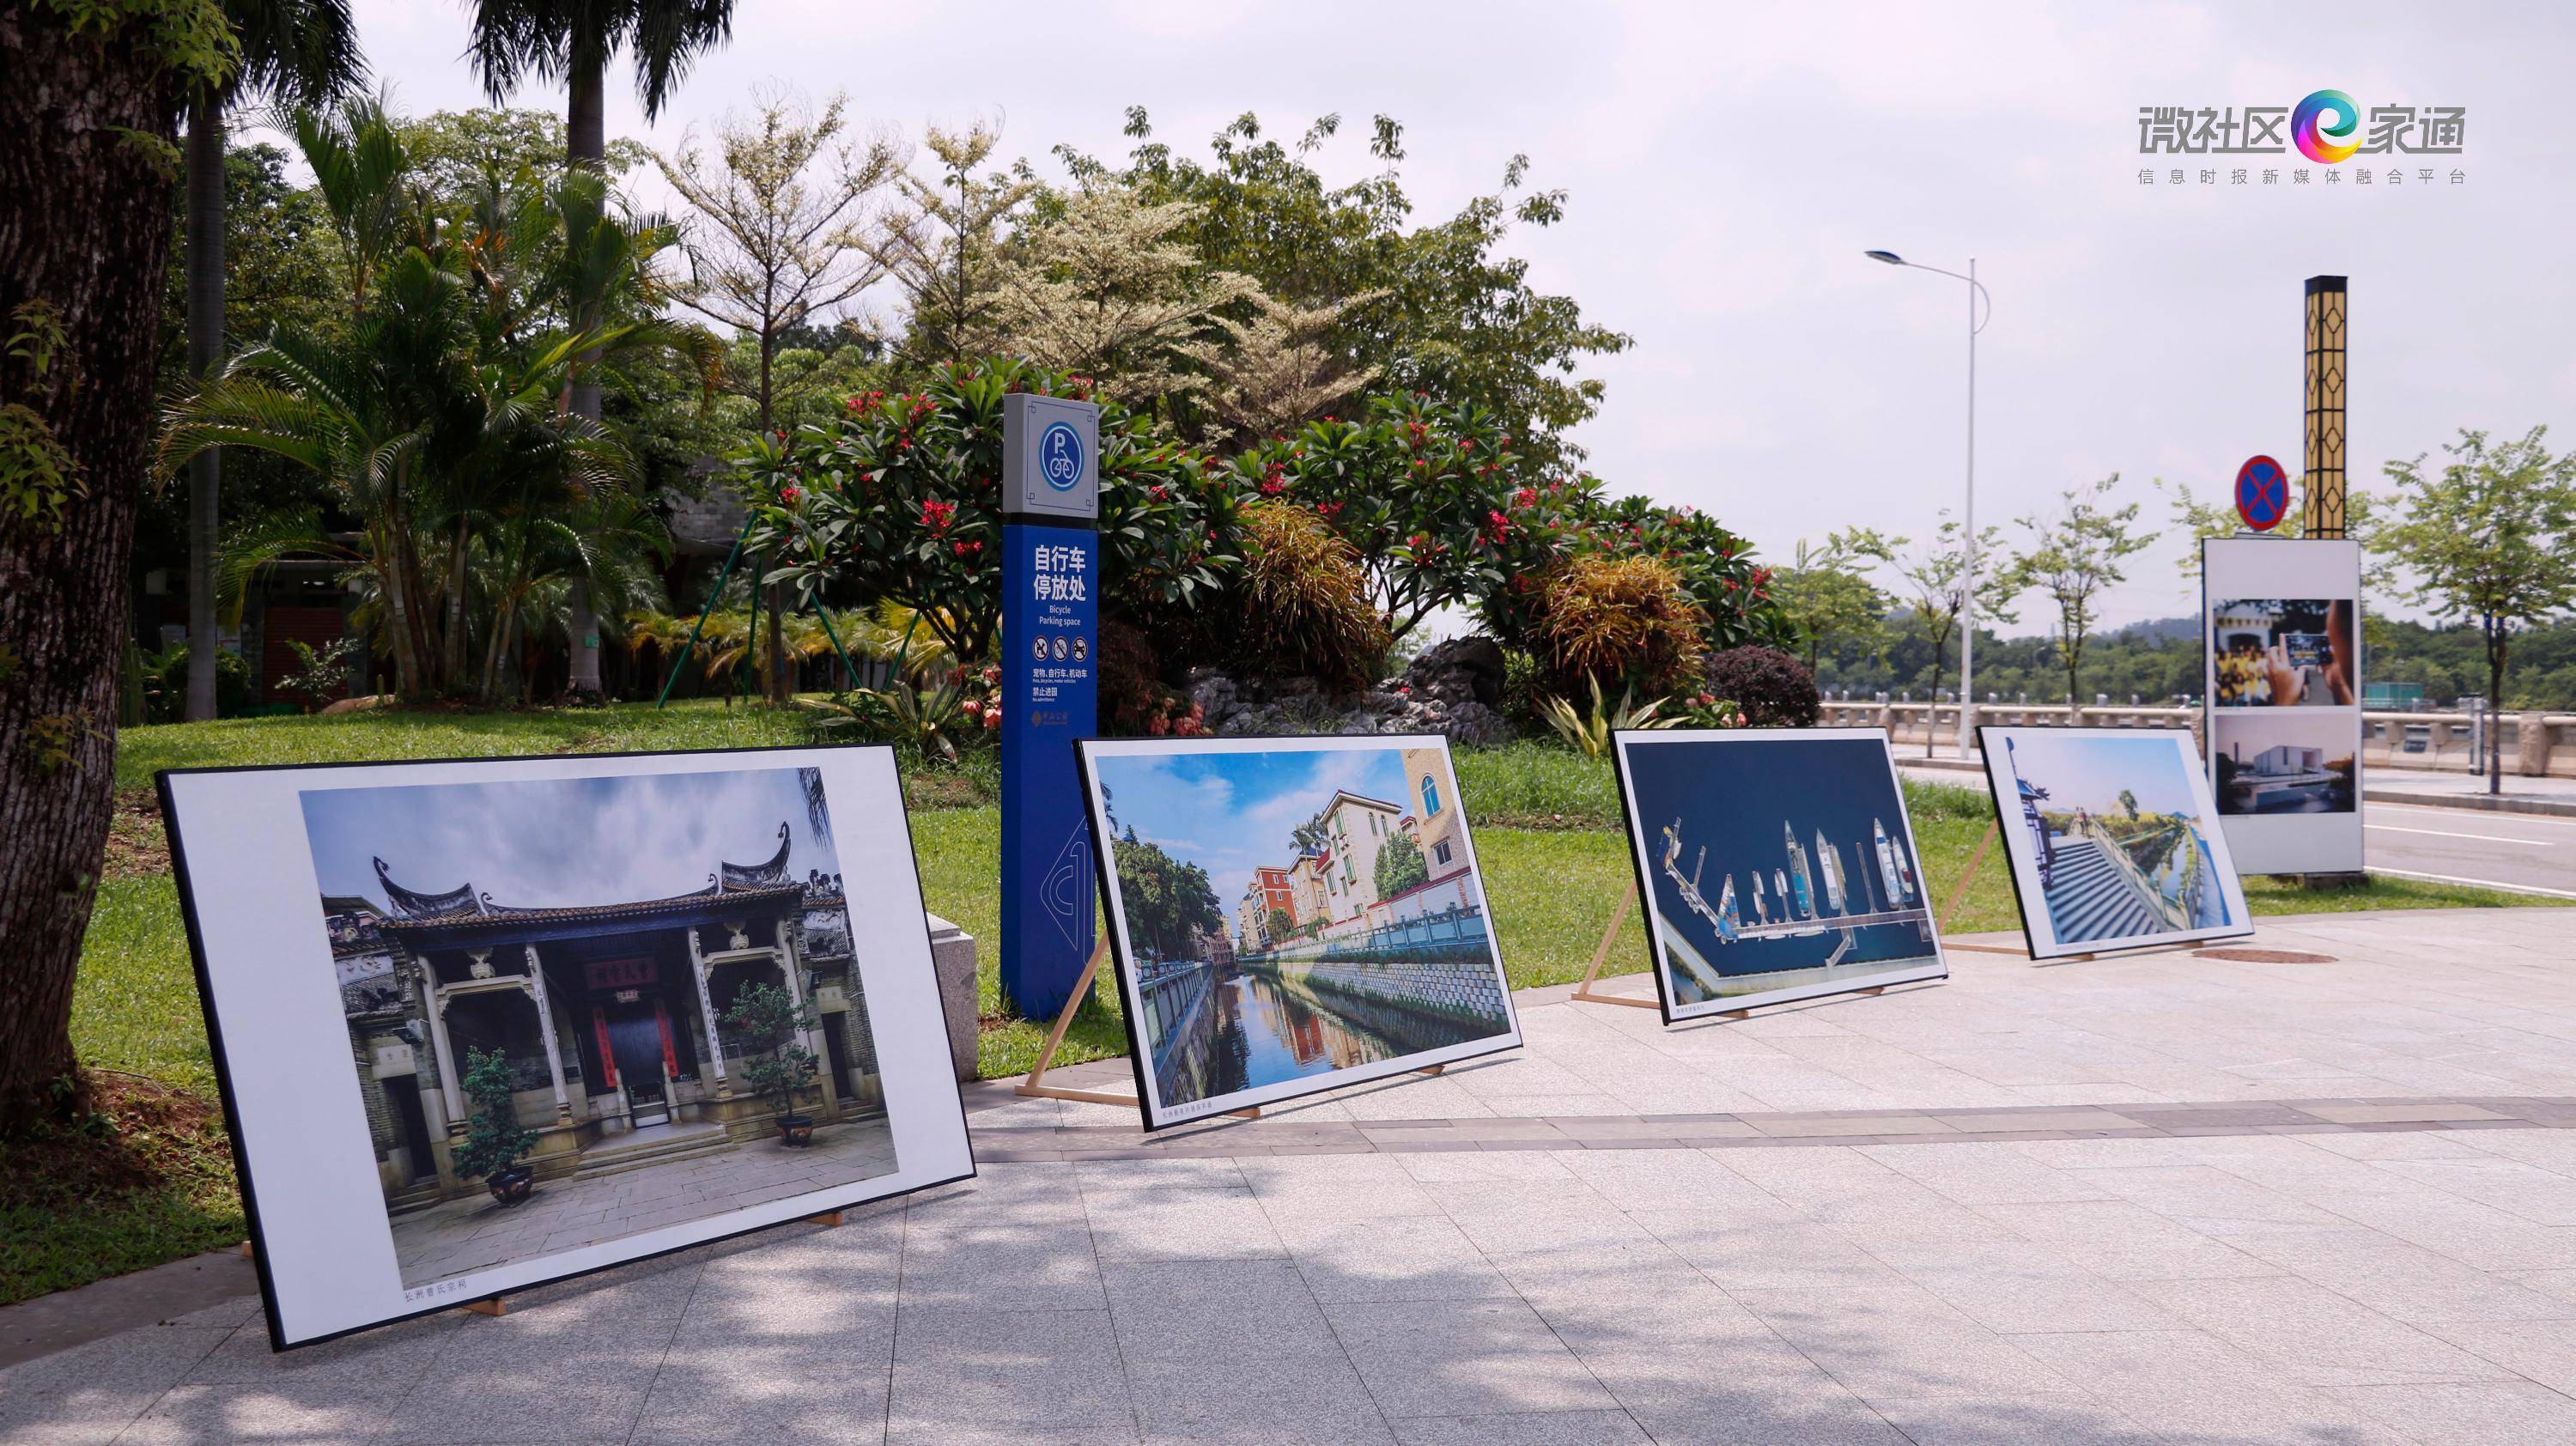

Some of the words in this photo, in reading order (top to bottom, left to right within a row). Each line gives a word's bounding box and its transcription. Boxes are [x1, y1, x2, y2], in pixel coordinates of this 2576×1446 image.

[1054, 432, 1066, 454] P
[1035, 544, 1086, 573] 自行车
[1033, 574, 1086, 601] 停放处
[1049, 605, 1072, 616] Bicycle
[1039, 616, 1063, 627] Parking
[1063, 618, 1081, 628] space
